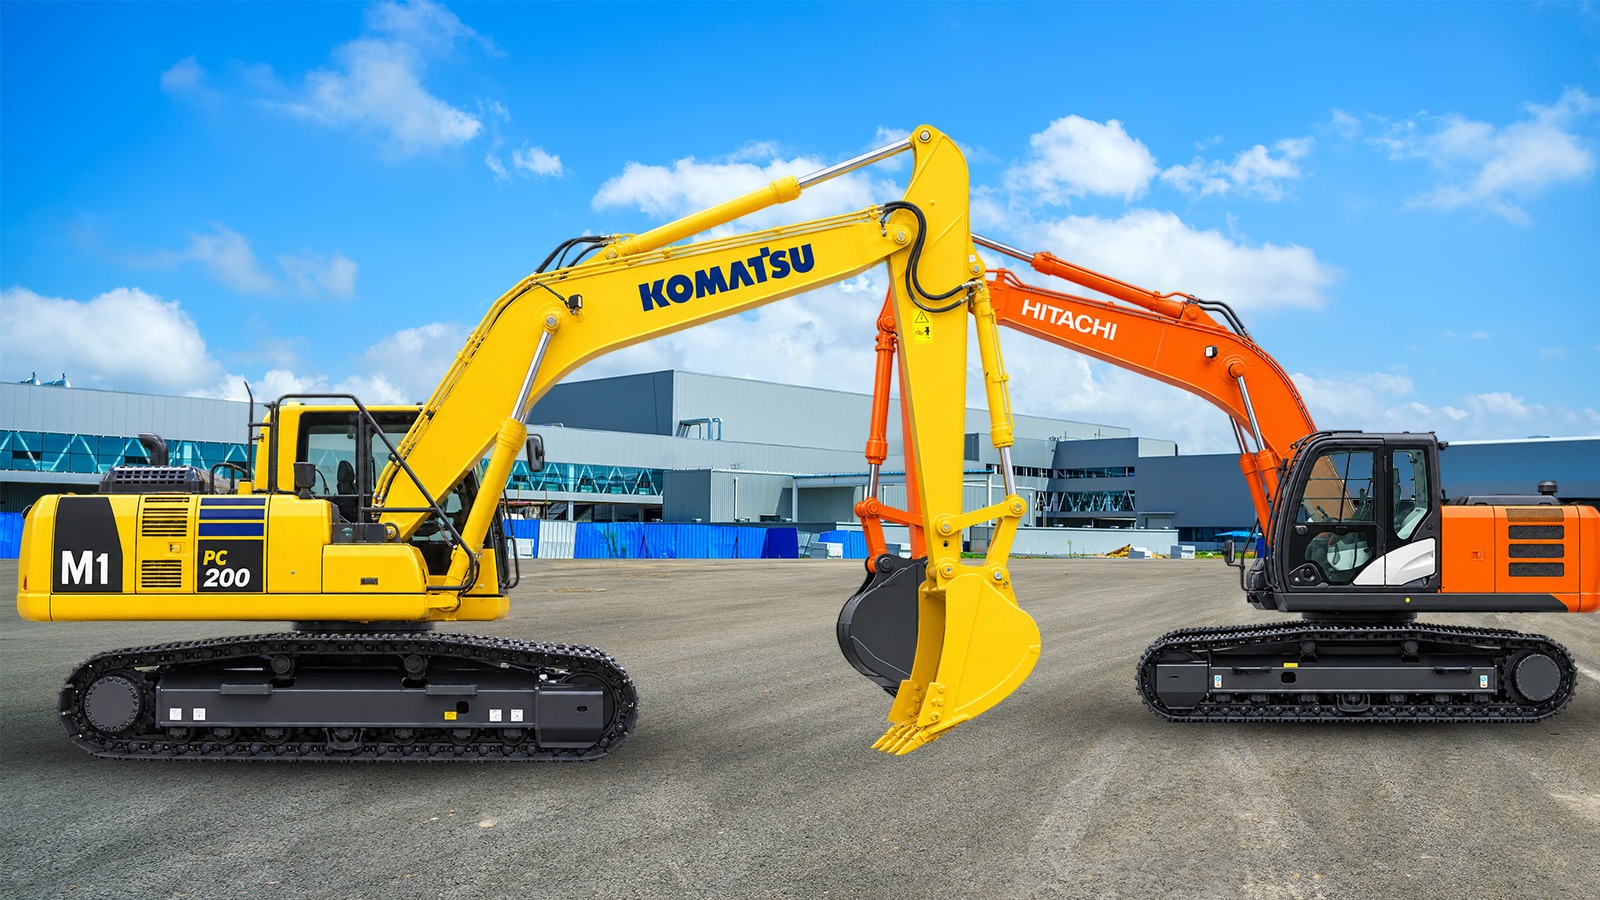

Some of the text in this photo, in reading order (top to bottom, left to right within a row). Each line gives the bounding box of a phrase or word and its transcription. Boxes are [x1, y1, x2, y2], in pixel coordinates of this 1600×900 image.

[638, 243, 815, 312] KOMATSU
[1021, 299, 1118, 341] HITACHI
[61, 550, 109, 585] M1
[203, 550, 228, 566] PC
[203, 568, 251, 588] 200
